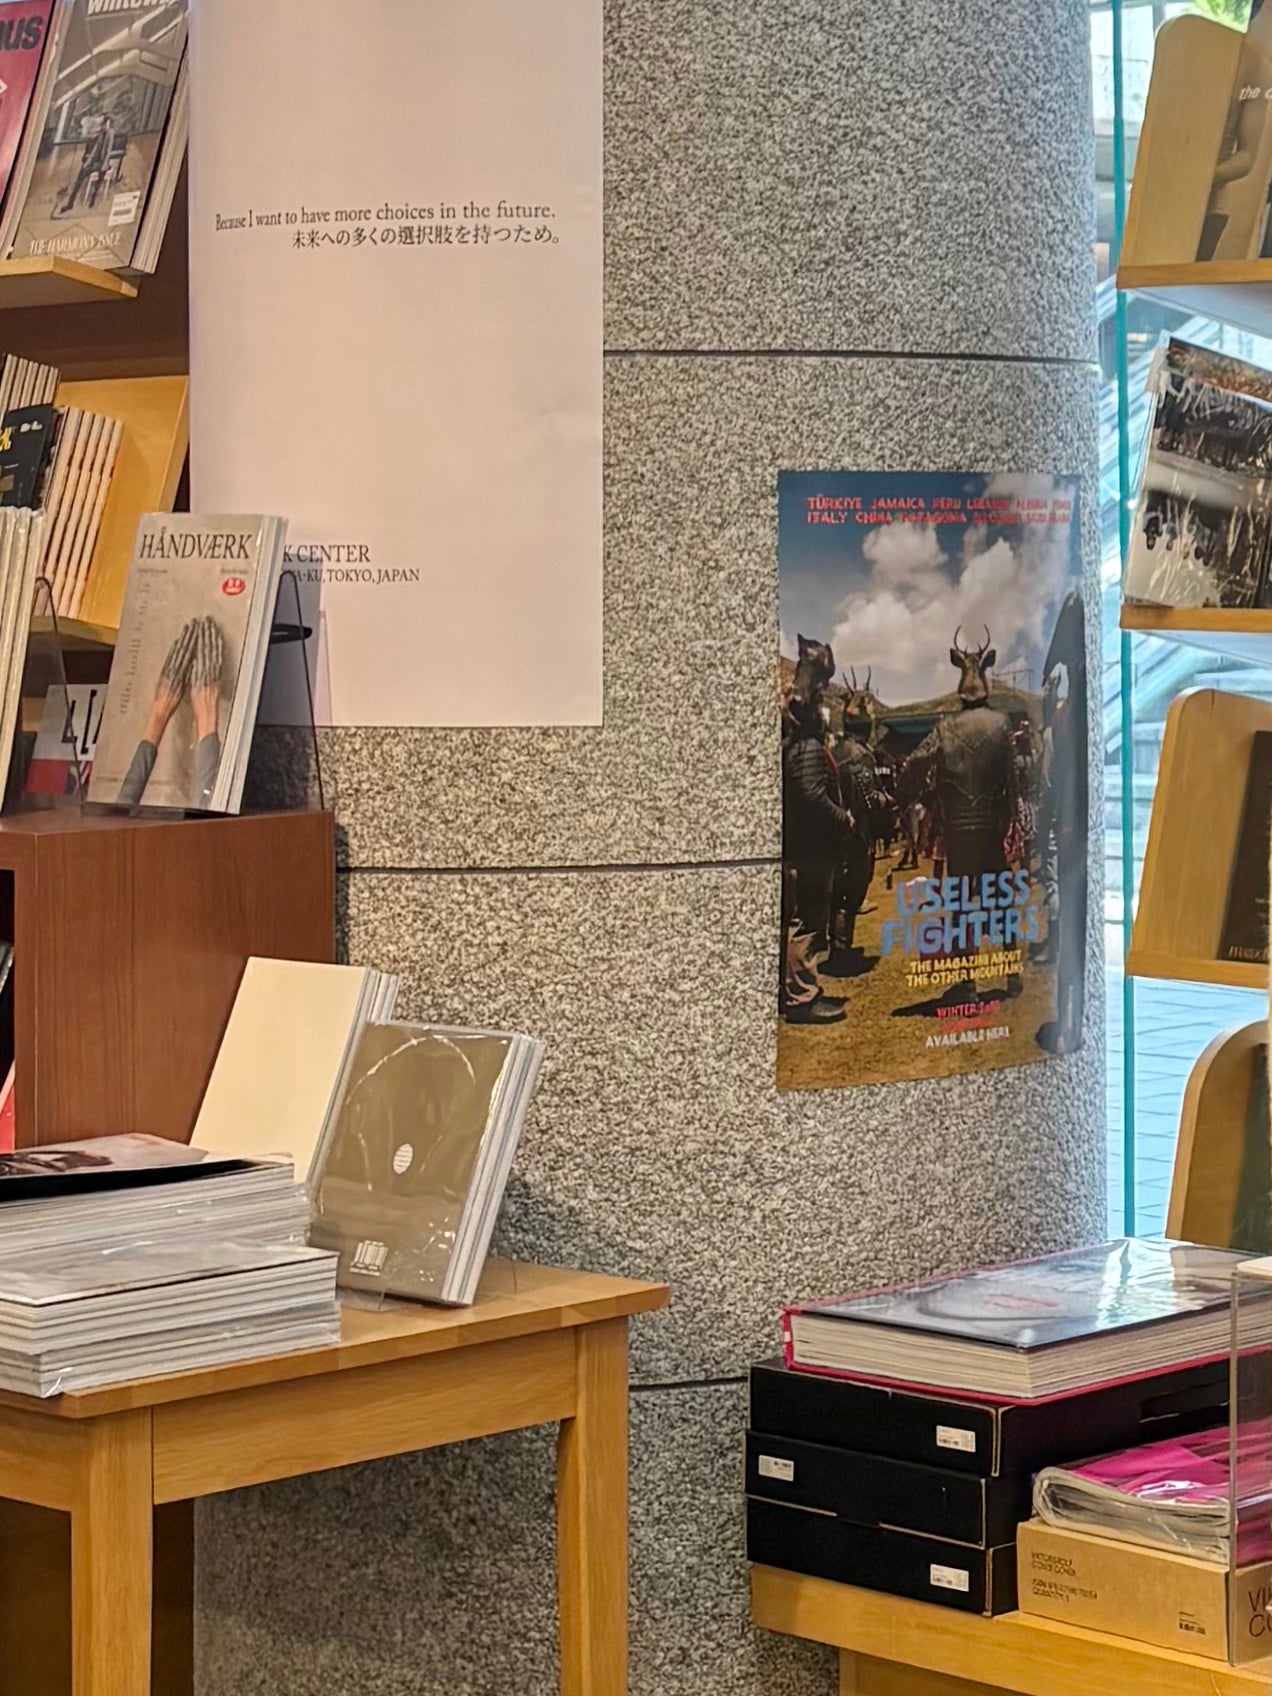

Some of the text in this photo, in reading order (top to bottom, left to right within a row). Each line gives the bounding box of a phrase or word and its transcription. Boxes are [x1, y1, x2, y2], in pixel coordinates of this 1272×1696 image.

[1239, 86, 1260, 101] the
[248, 209, 254, 227] I
[256, 211, 282, 226] want
[285, 211, 298, 225] to
[301, 206, 331, 224] have
[334, 208, 372, 222] more
[376, 202, 435, 220] choices
[440, 202, 456, 219] in
[463, 201, 491, 219] the
[497, 199, 556, 219] future.
[139, 526, 253, 560] HÅNDVÆRK
[297, 544, 371, 563] CENTER
[327, 568, 420, 585] TOKYO, JAPAN
[896, 869, 1031, 917] USELESS
[881, 904, 1039, 955] FIGHTERS
[909, 959, 931, 974] THE
[905, 972, 929, 988] THE
[931, 967, 968, 985] OTHER
[925, 1028, 984, 1049] AVAILABLE
